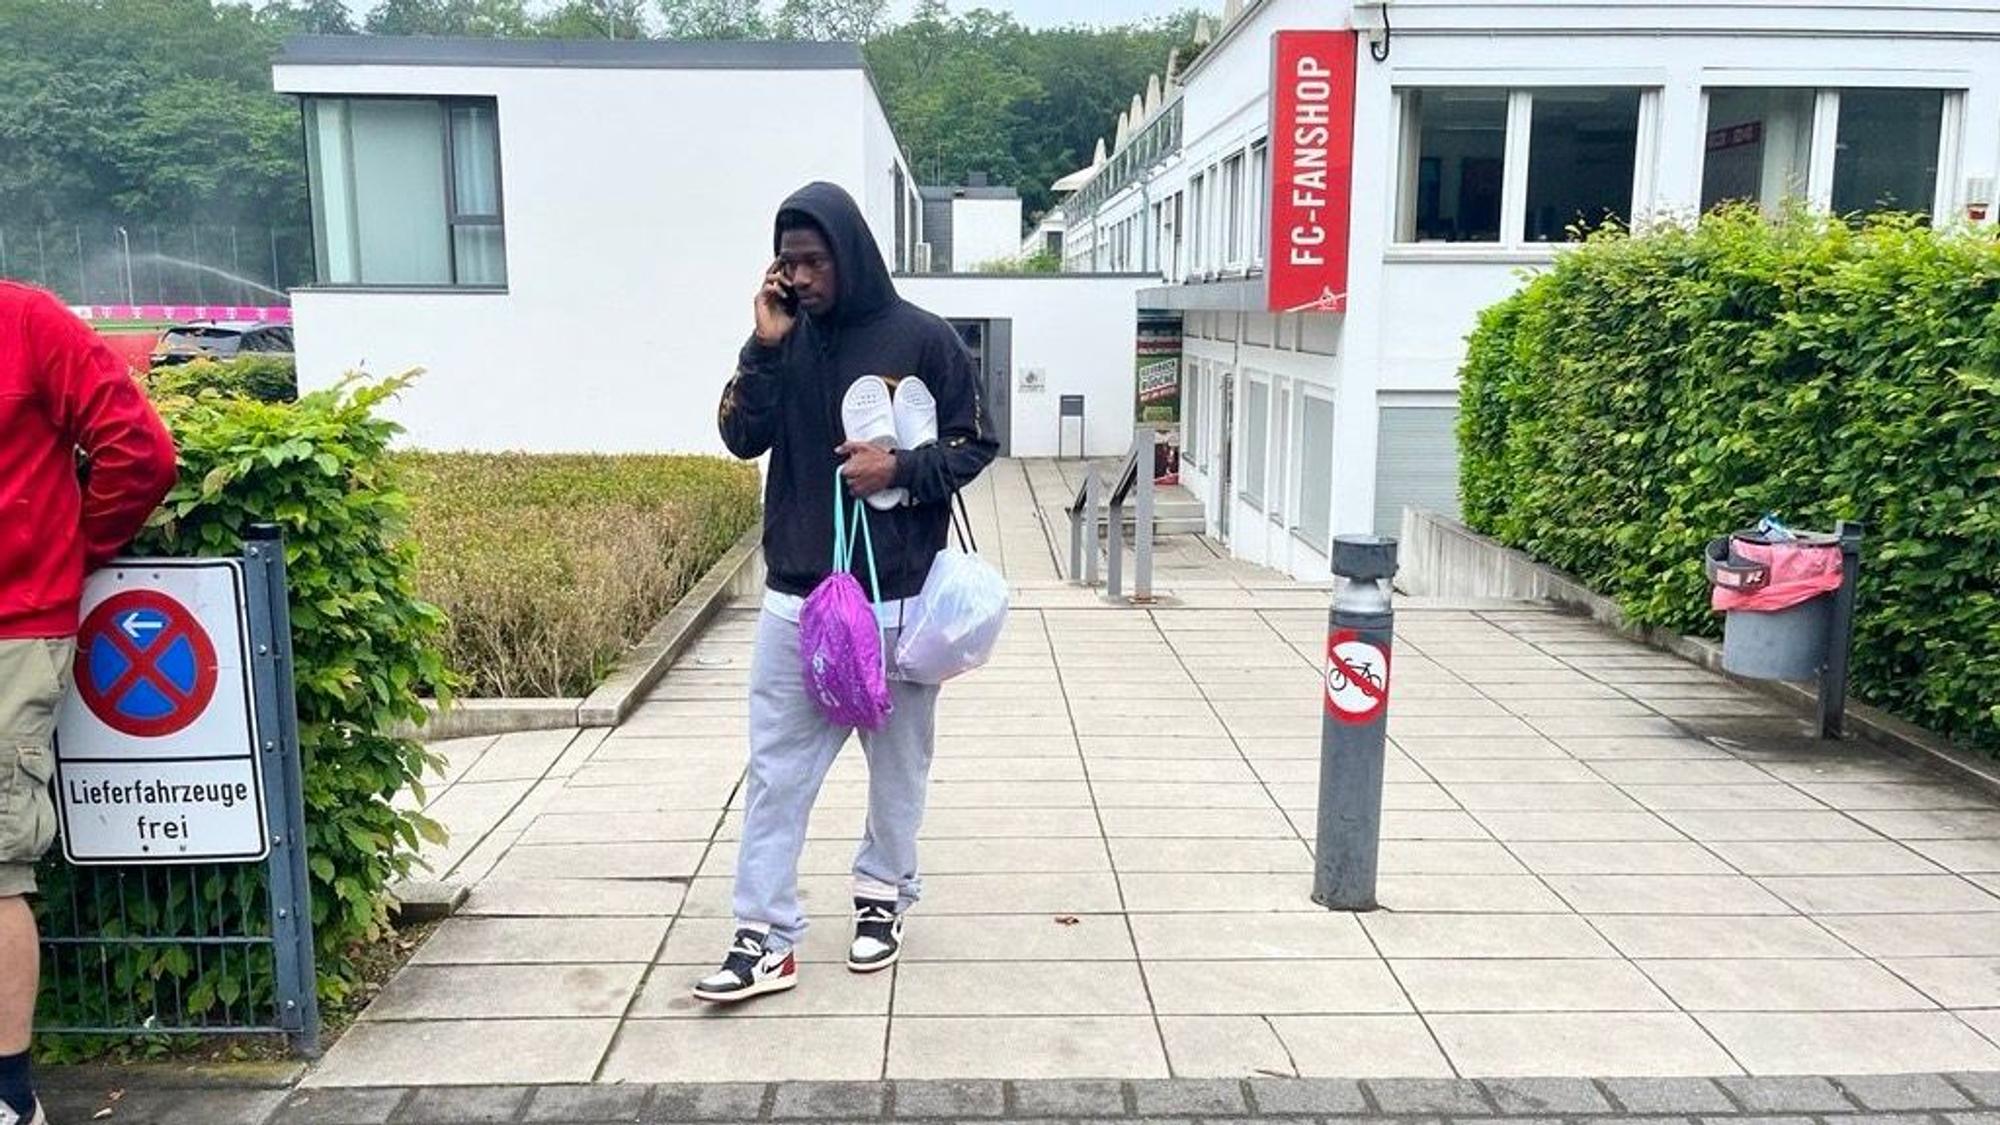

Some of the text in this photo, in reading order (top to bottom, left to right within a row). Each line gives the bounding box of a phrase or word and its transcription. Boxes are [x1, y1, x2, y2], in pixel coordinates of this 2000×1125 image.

[1290, 56, 1331, 266] FC-FANSHOP
[69, 779, 248, 808] Lieferfahrzeuge
[137, 814, 189, 840] frei
